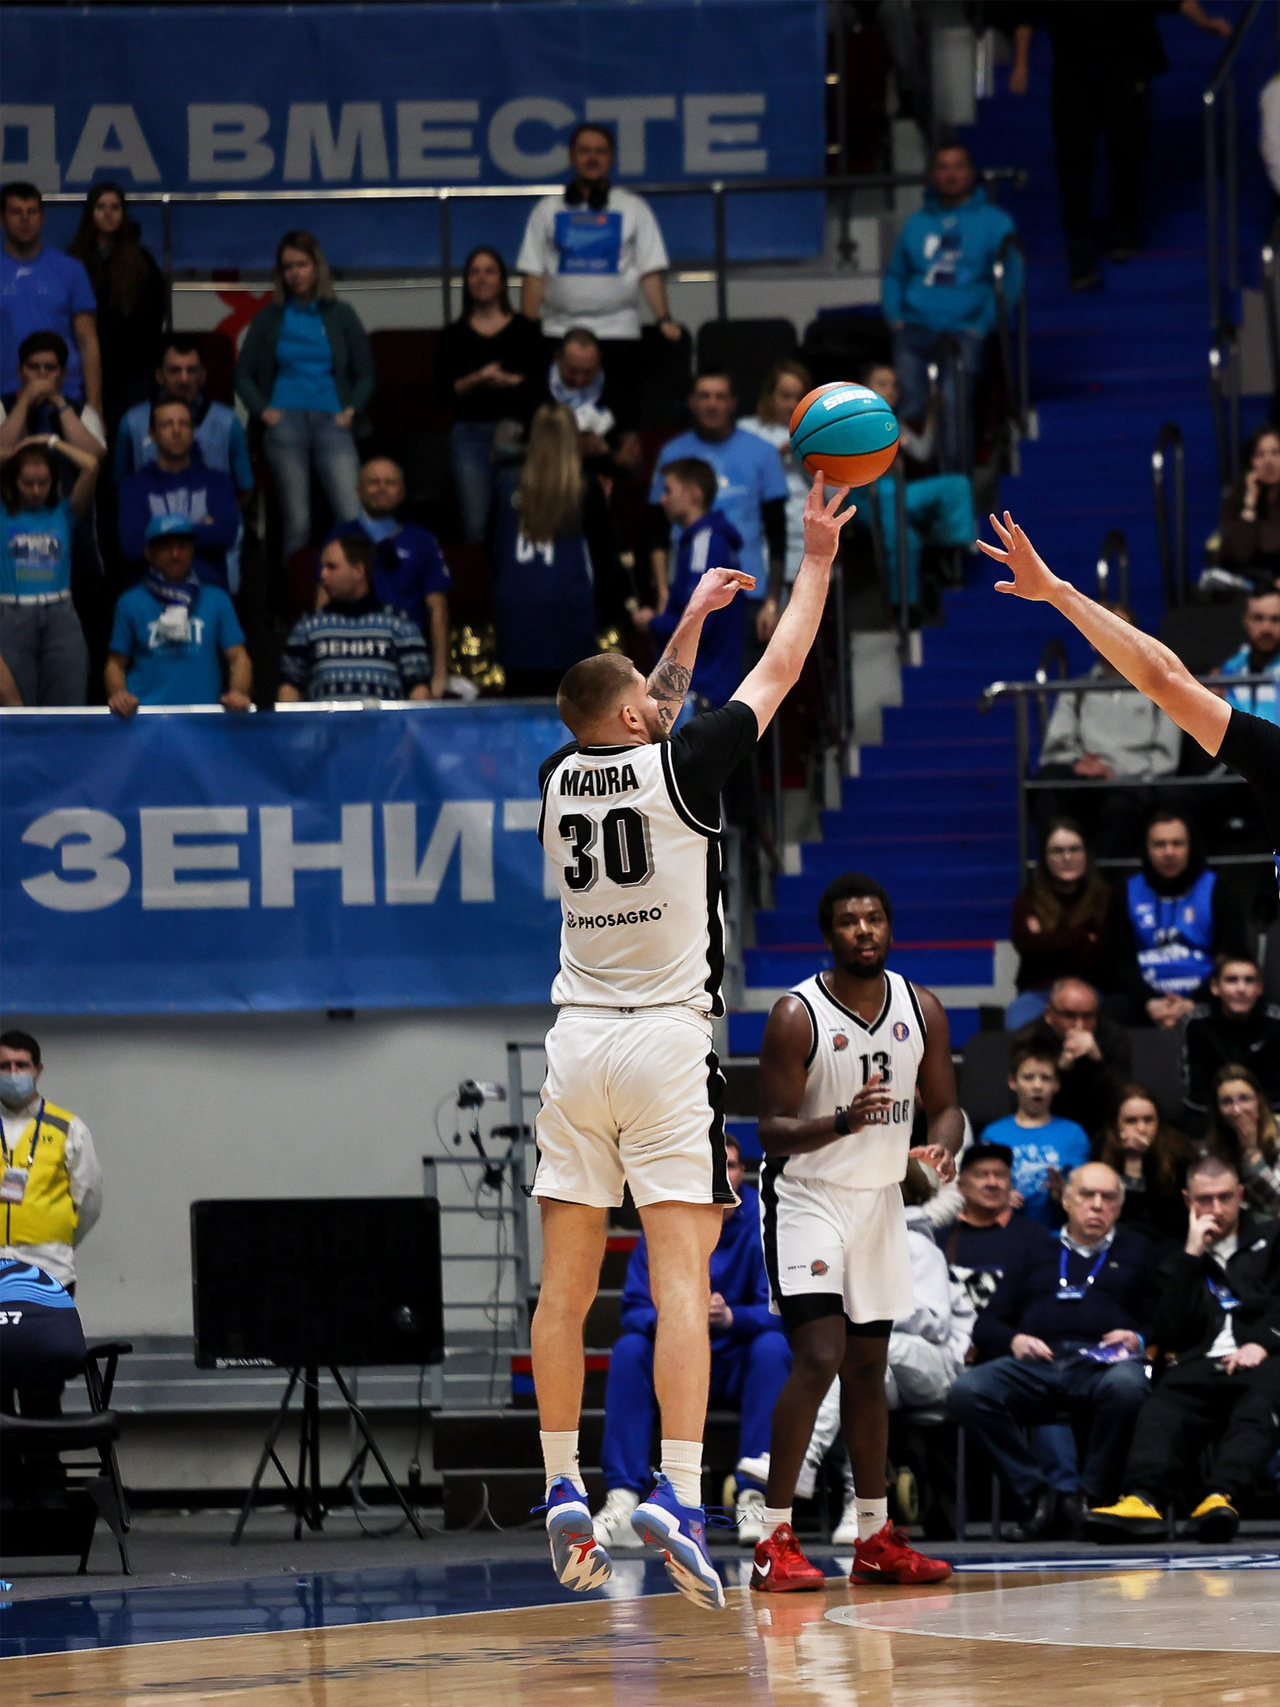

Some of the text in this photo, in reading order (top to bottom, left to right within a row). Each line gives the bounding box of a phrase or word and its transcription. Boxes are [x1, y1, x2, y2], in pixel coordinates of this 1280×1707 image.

[187, 93, 768, 184] ВМЕСТЕ
[560, 763, 640, 797] MAURA
[558, 807, 656, 894] 30
[578, 907, 663, 930] PHOSAGRO
[859, 1051, 893, 1086] 13
